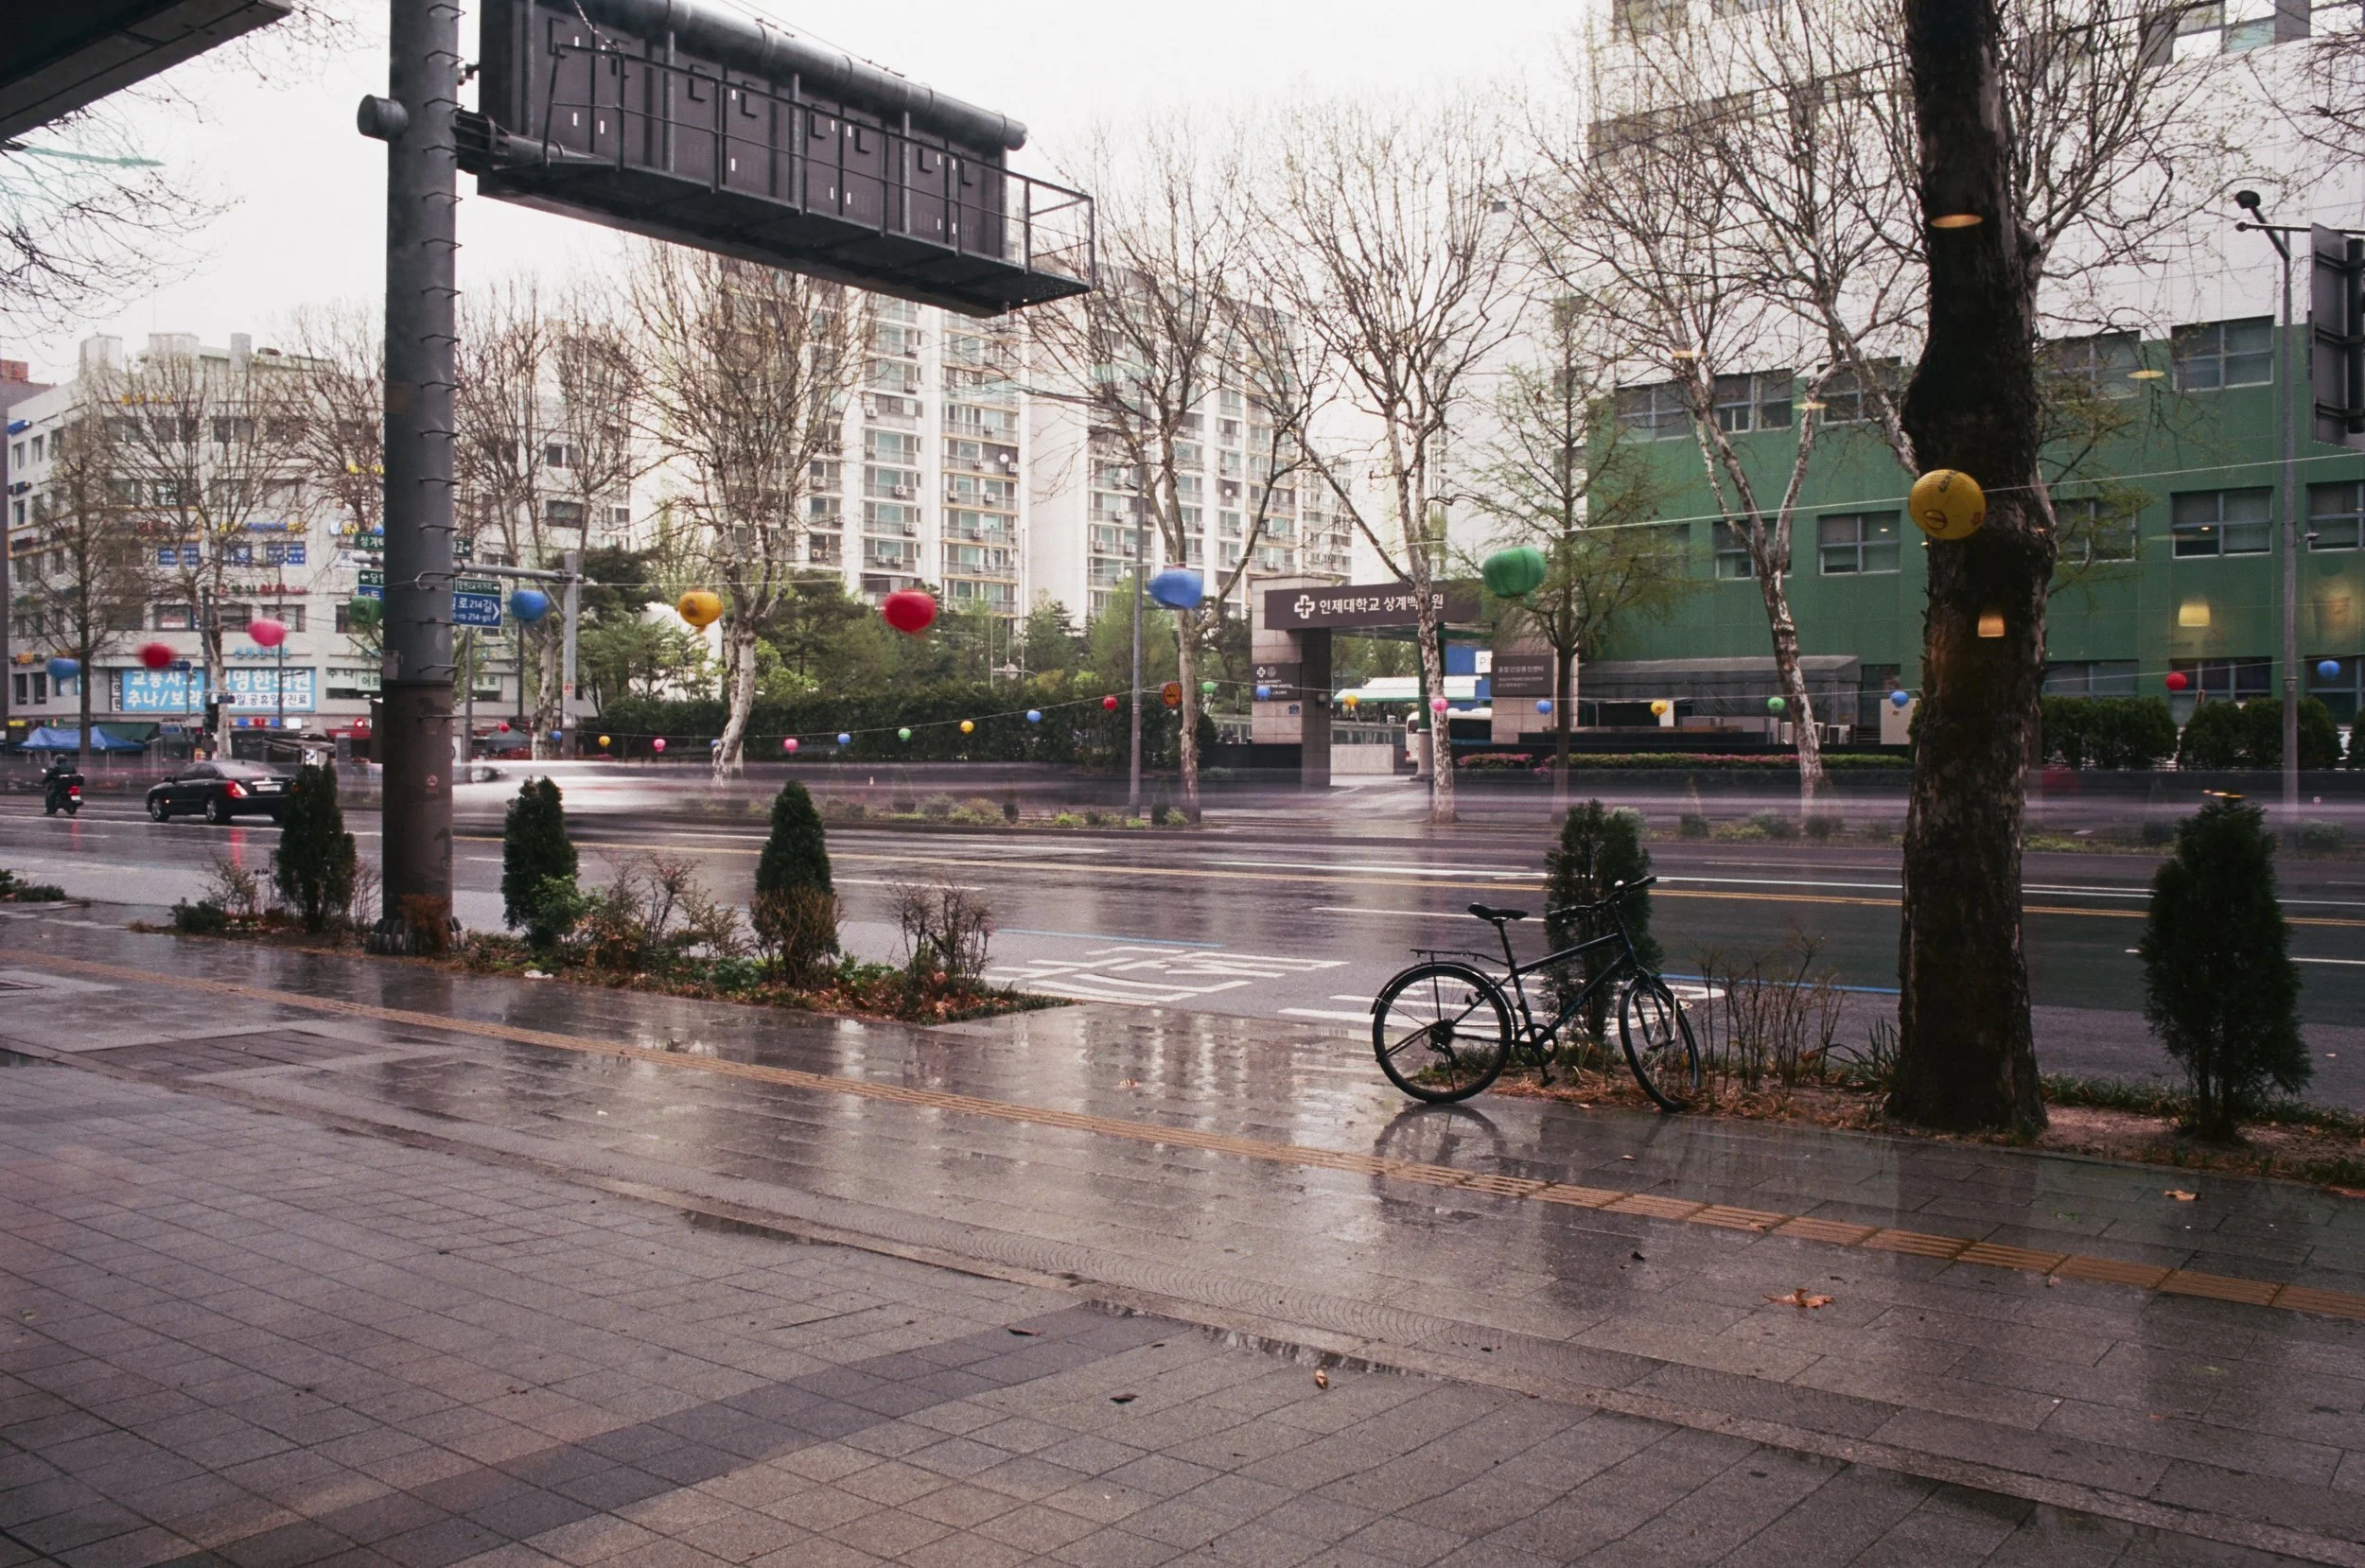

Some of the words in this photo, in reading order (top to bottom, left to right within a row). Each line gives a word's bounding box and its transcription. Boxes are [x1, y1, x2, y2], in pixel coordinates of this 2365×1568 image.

[453, 597, 492, 613] 로214길
[1320, 598, 1380, 615] 인제대학교
[1383, 593, 1444, 612] 상계백원
[225, 670, 311, 691] 명한의원
